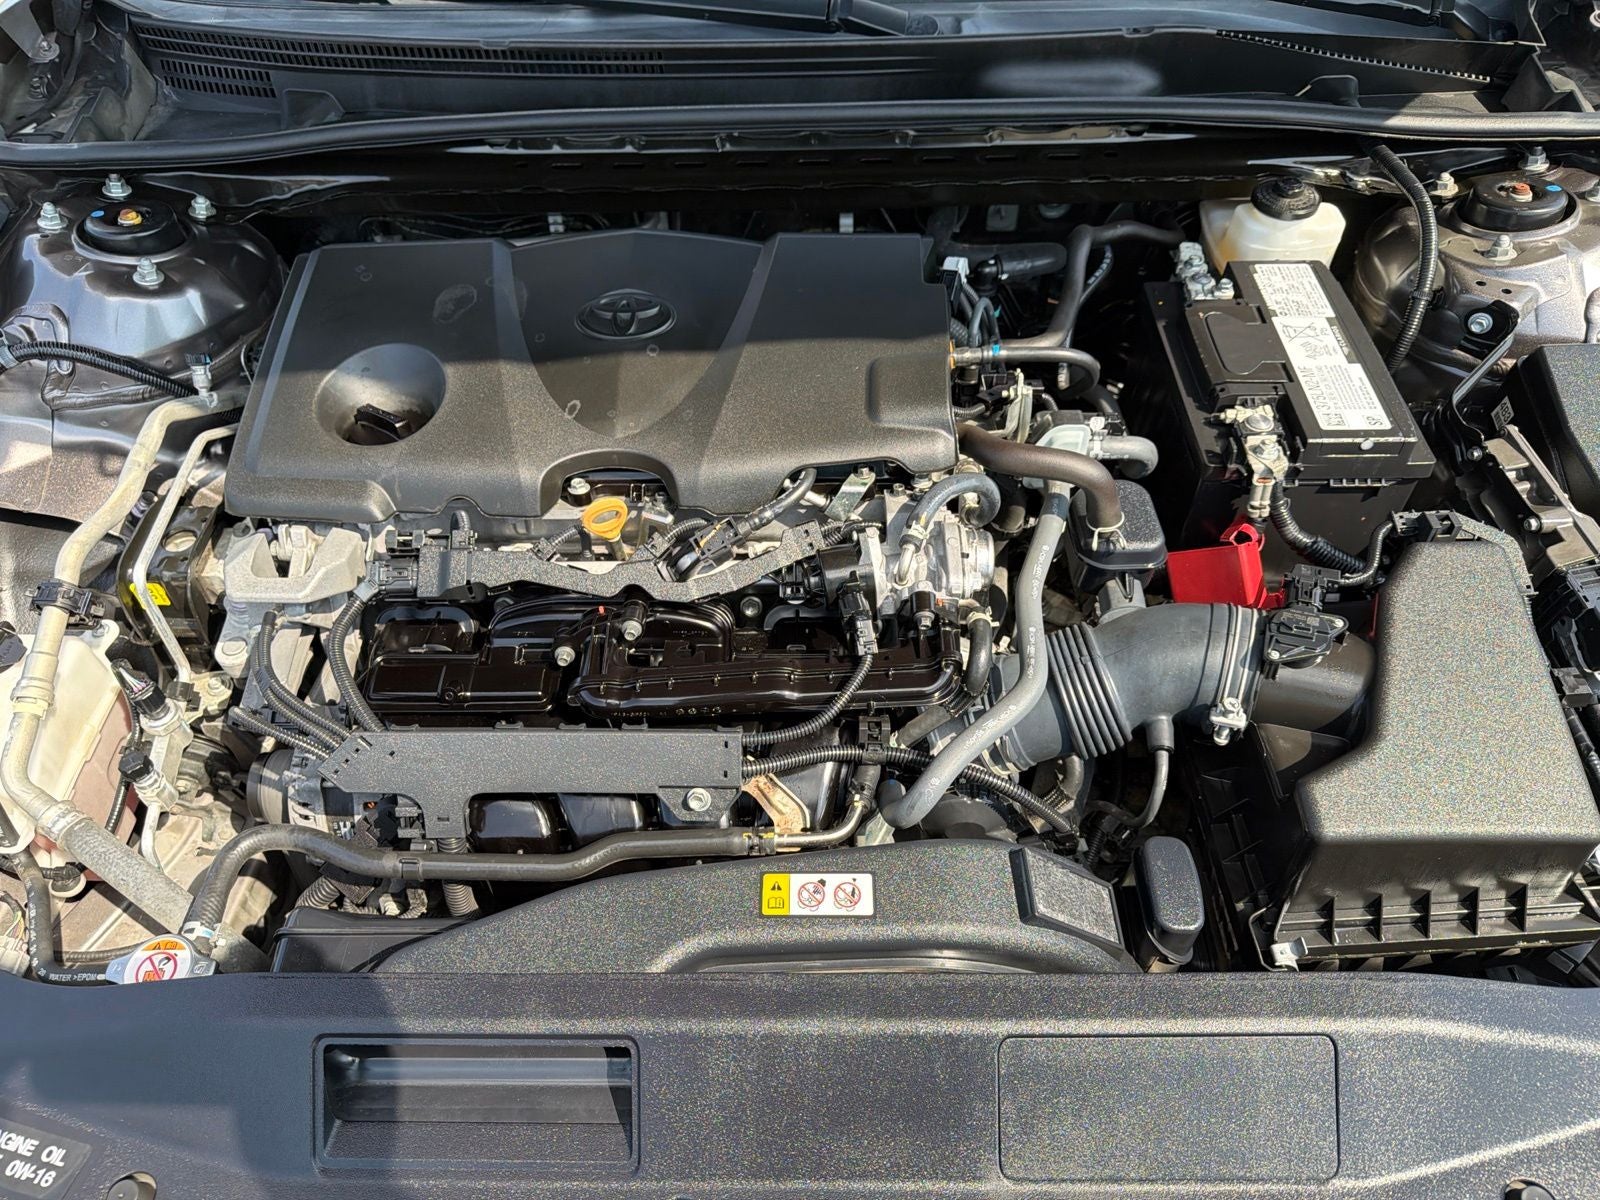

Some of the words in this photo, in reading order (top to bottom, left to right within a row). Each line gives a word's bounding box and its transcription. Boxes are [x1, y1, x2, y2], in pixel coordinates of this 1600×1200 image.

[48, 973, 71, 982] WATER
[41, 1145, 66, 1167] OIL
[5, 1160, 56, 1188] 0W-16
